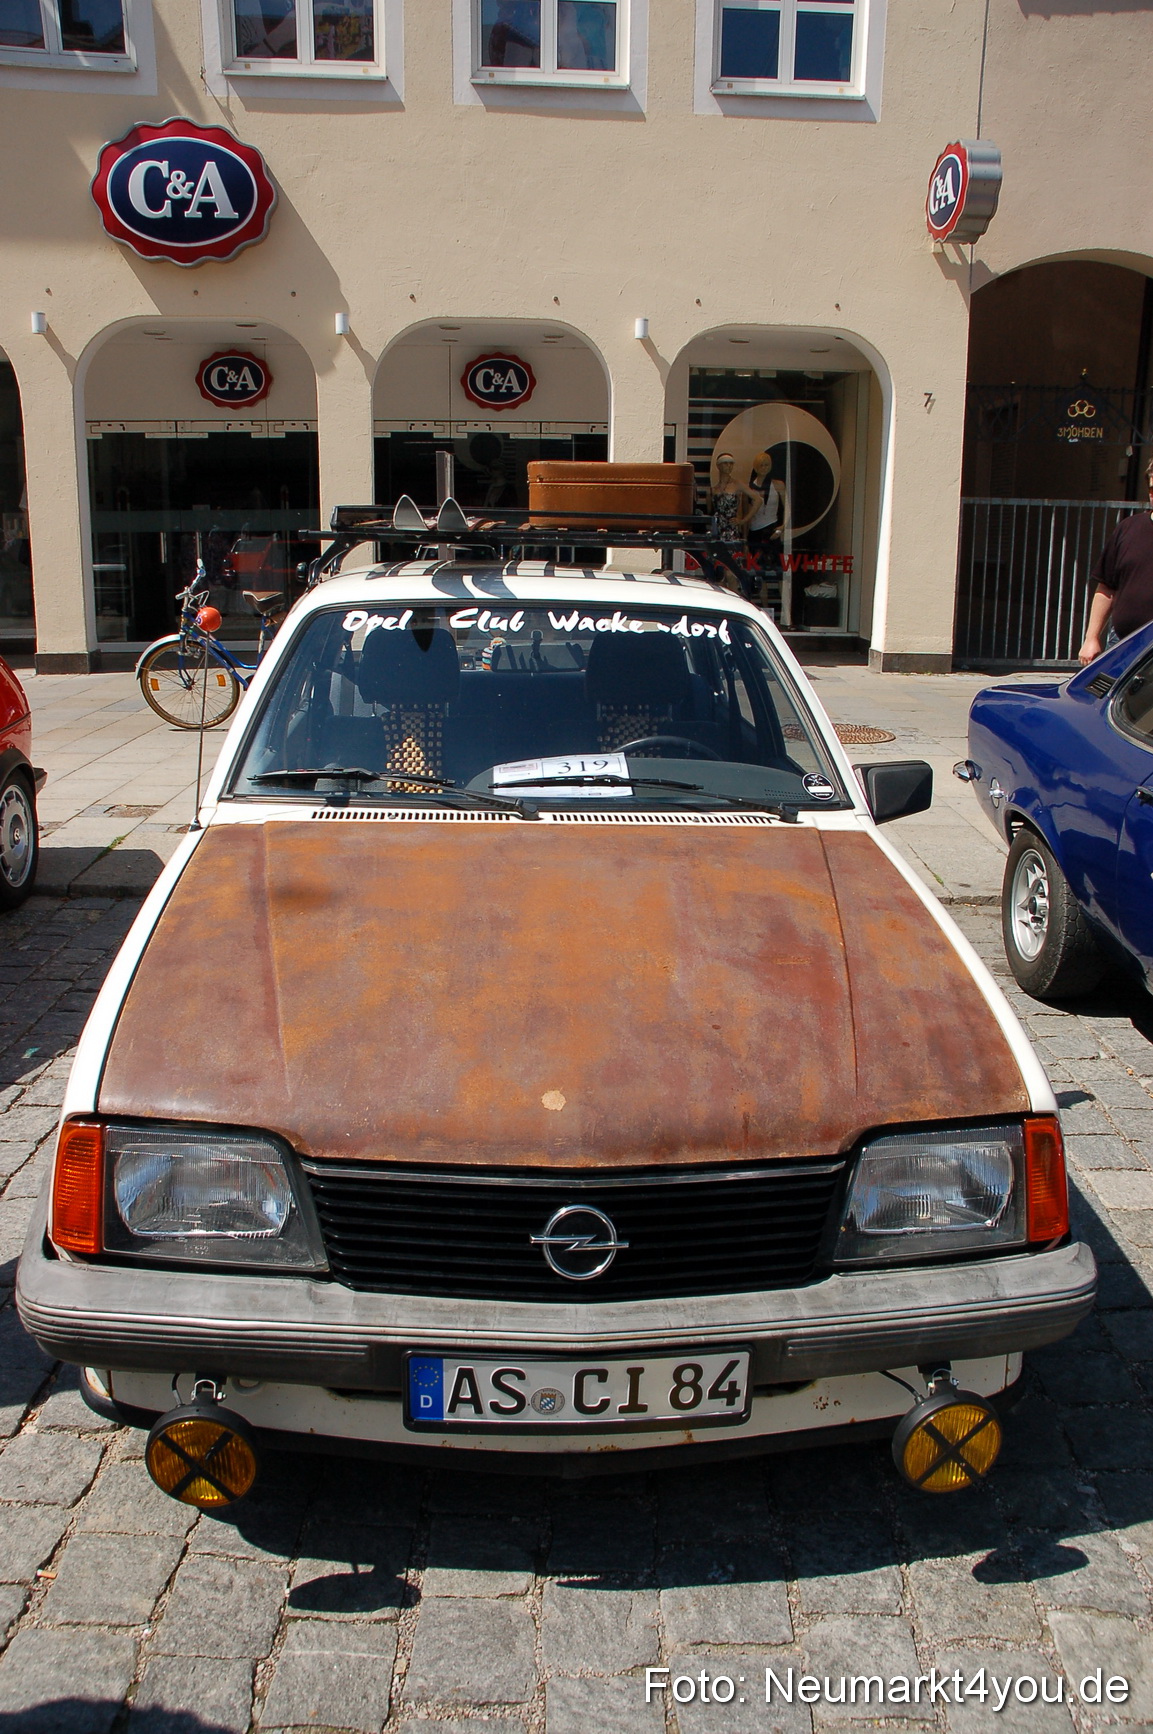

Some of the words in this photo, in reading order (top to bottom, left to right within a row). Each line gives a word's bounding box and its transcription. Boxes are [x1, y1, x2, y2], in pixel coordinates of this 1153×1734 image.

[128, 160, 239, 219] C&A
[929, 166, 956, 215] C&A
[210, 366, 258, 391] C&A
[475, 368, 522, 393] C&A
[923, 392, 933, 408] 7
[780, 553, 854, 574] WHITE
[341, 609, 414, 636] Opel
[449, 608, 525, 633] Club
[557, 759, 609, 774] 319
[420, 1394, 433, 1409] D
[446, 1365, 527, 1415] AS
[573, 1366, 649, 1415] CI
[668, 1359, 742, 1411] 84
